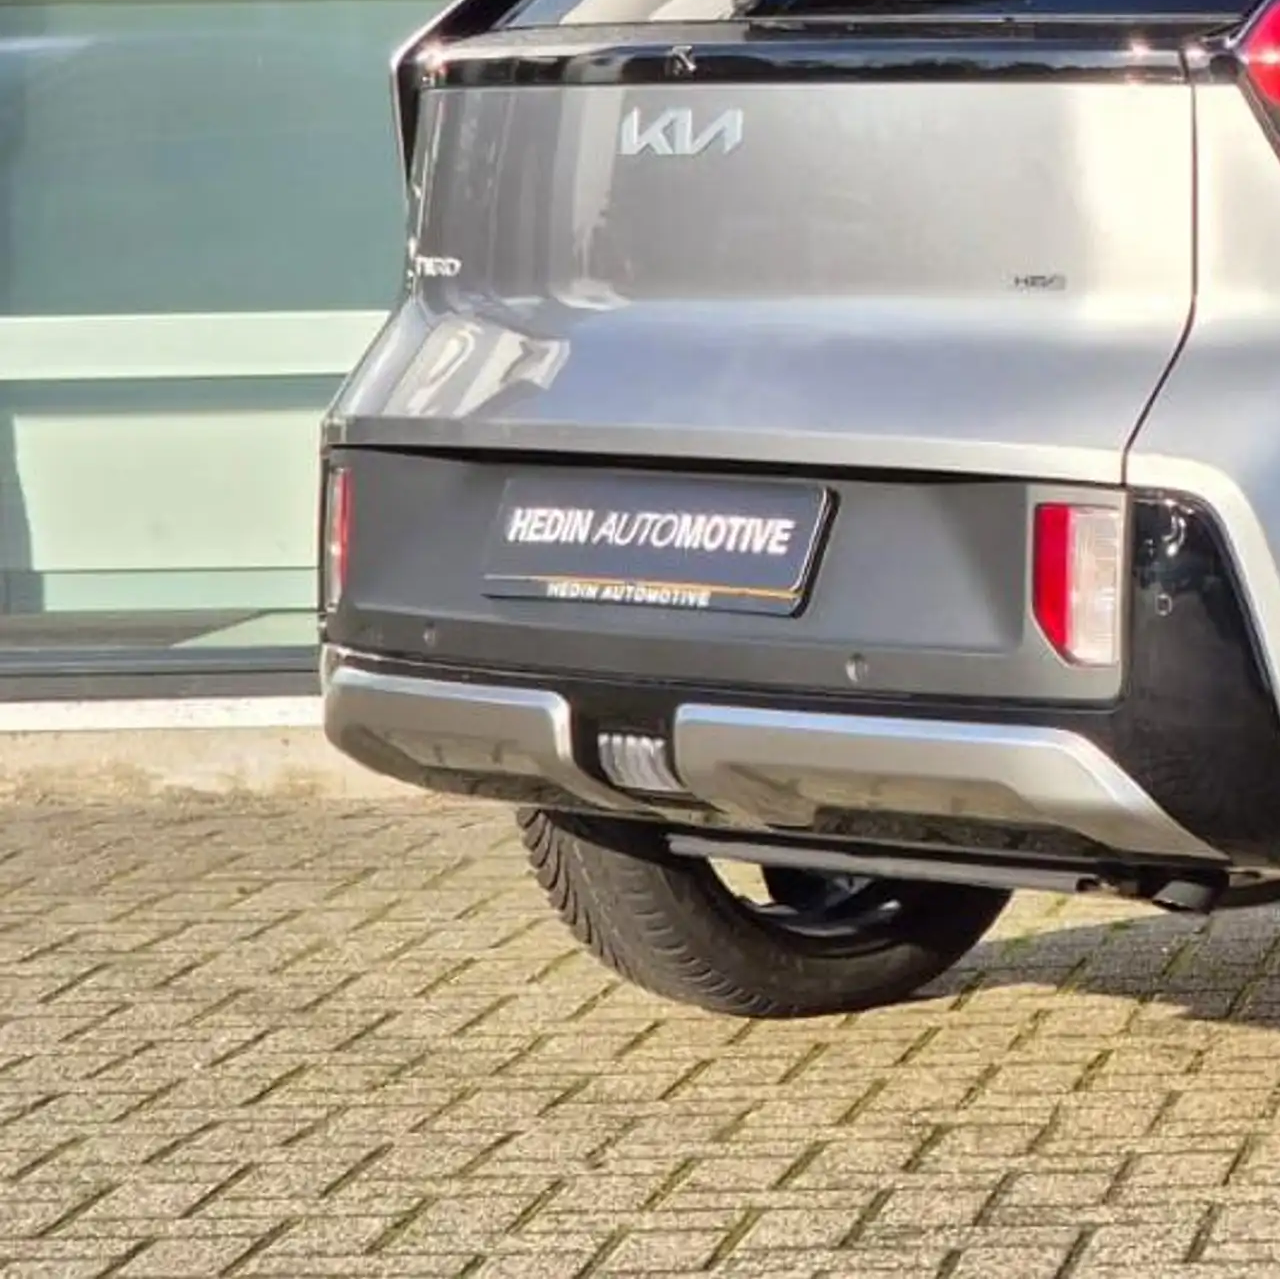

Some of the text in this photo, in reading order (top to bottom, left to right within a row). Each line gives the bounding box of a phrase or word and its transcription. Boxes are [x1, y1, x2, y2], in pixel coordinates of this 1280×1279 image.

[620, 107, 744, 155] KIA
[507, 508, 796, 555] HEDIN AUTOMOTIVE
[546, 582, 712, 608] HEDIN AUTOMOTIVE
